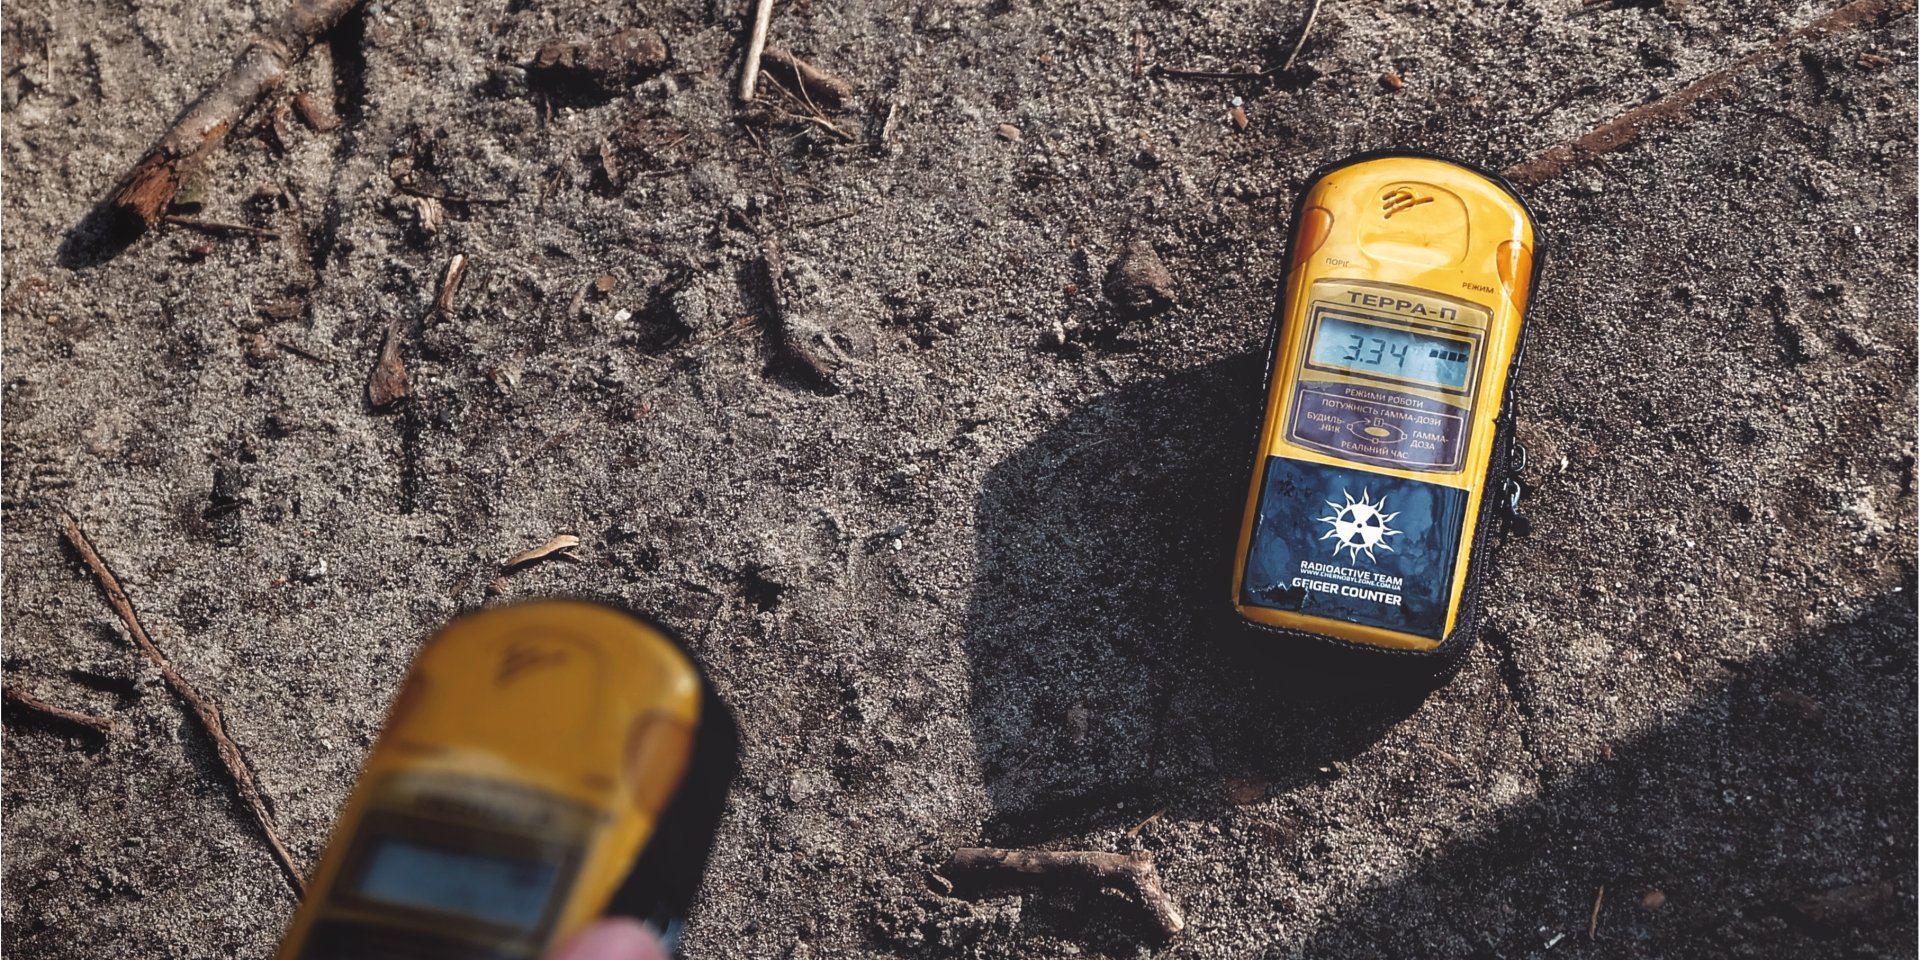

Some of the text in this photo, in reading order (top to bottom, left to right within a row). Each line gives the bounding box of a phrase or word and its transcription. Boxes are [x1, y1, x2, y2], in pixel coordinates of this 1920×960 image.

[1462, 281, 1495, 294] РЕЖИМ
[1347, 290, 1457, 321] ТЕРРА-П
[1343, 334, 1409, 368] 3.34
[1345, 387, 1424, 408] РЕЖИМИ РОБОТИ
[1306, 411, 1345, 424] БУДИЛЬ-
[1321, 398, 1442, 426] ПОТУЖНІСТЬ ГАММА-ДОЗИ
[1409, 440, 1435, 450] ДОЗА
[1412, 430, 1449, 443] ГАММА-
[1341, 440, 1409, 459] РЕАЛЬНИЙ ЧАС
[1300, 560, 1403, 586] RADIOACTIVE TEAM
[1340, 585, 1402, 606] COUNTER
